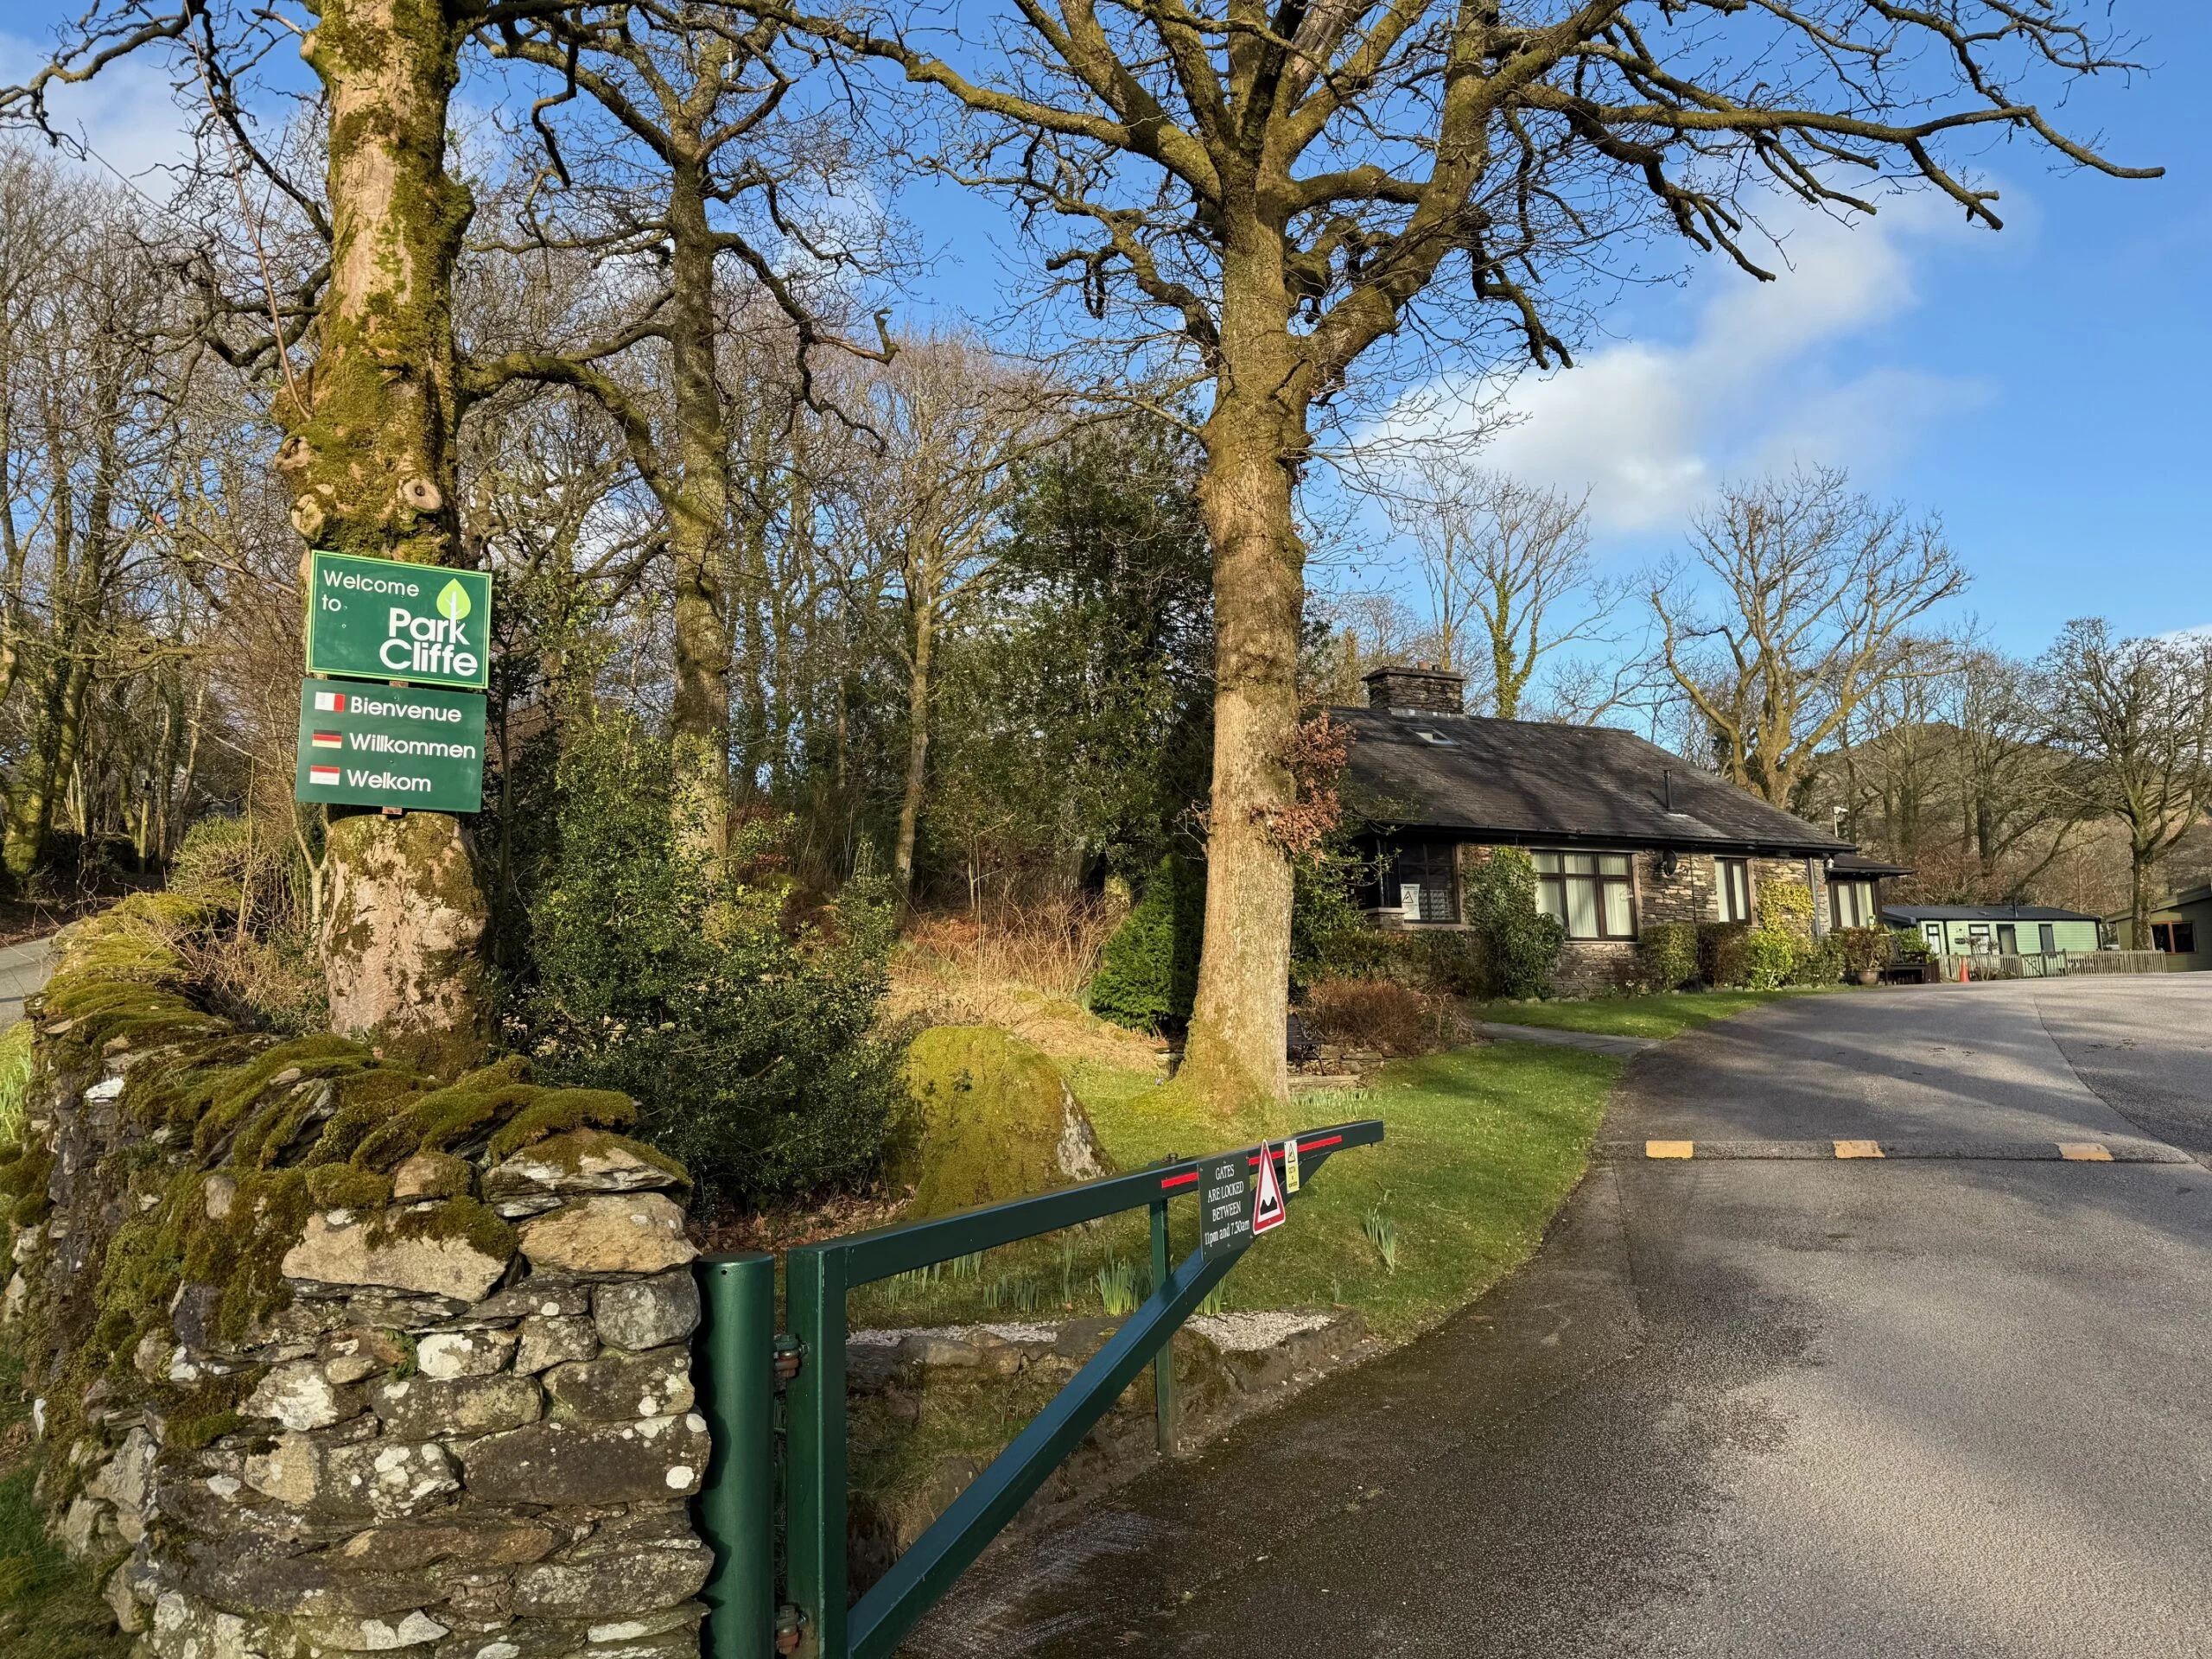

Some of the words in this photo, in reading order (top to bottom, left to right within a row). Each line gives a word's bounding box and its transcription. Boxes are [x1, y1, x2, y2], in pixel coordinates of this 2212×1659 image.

[323, 569, 420, 598] Welcome
[321, 594, 342, 612] to
[389, 605, 471, 645] Park
[379, 638, 479, 677] Cliffe
[350, 696, 462, 723] Bienvenue
[349, 732, 476, 760] Willkommen
[346, 769, 431, 792] Welkom
[1215, 1164, 1235, 1180] GATES
[1207, 1187, 1221, 1204] ARE
[1221, 1180, 1244, 1199] LOCKED
[1212, 1201, 1242, 1222] BETWEEN
[1219, 1223, 1230, 1240] and
